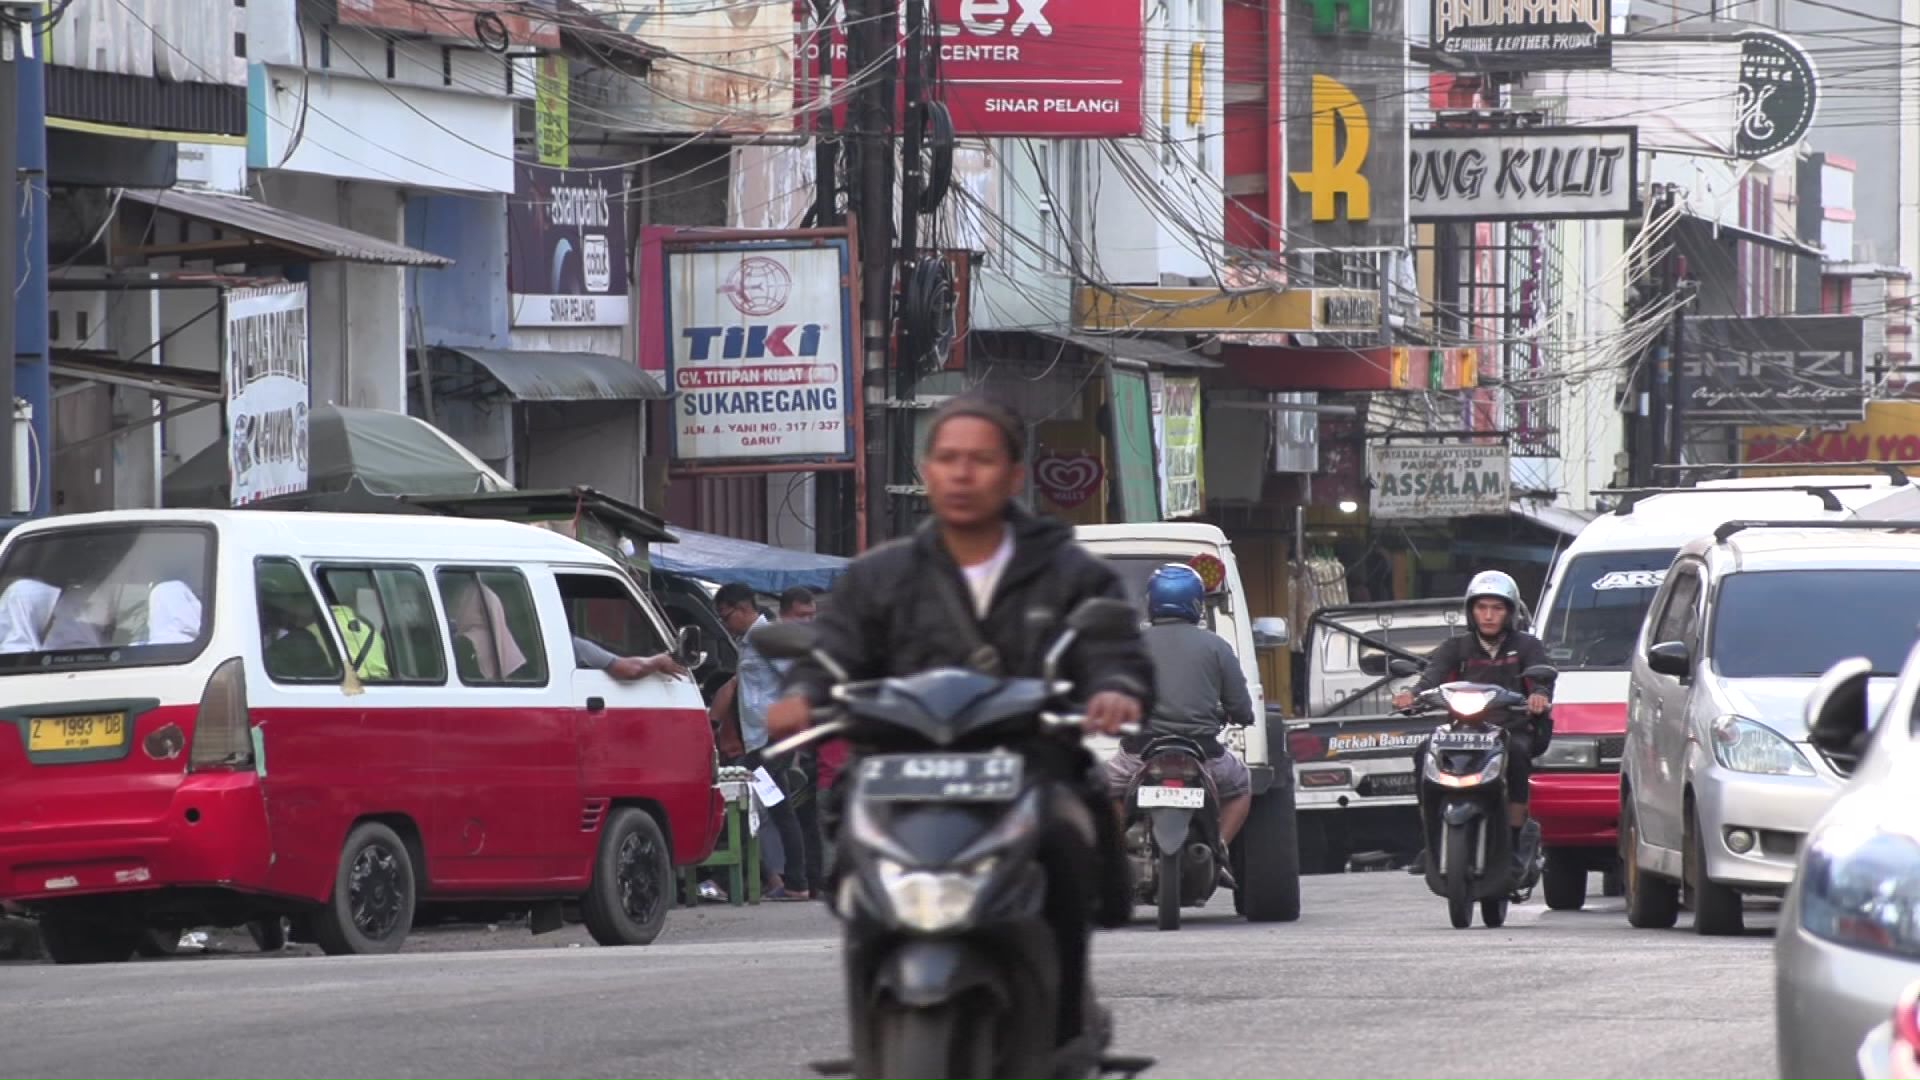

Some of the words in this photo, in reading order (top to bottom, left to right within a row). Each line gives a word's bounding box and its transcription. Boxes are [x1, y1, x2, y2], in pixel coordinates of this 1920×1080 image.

[1496, 34, 1550, 51] LEATHER
[940, 44, 1020, 61] CENTER
[985, 98, 1041, 113] SINAR
[1043, 98, 1120, 113] PELANGI
[1494, 146, 1625, 199] KULIT
[679, 371, 702, 386] CV.
[705, 369, 760, 385] TITIPAN
[683, 387, 837, 417] SUKAREGANG
[728, 423, 757, 434] YANI
[786, 421, 807, 432] 317
[741, 436, 782, 447] GARUT
[32, 719, 41, 739] Z
[62, 717, 94, 737] 1993
[1328, 734, 1377, 751] Berkah
